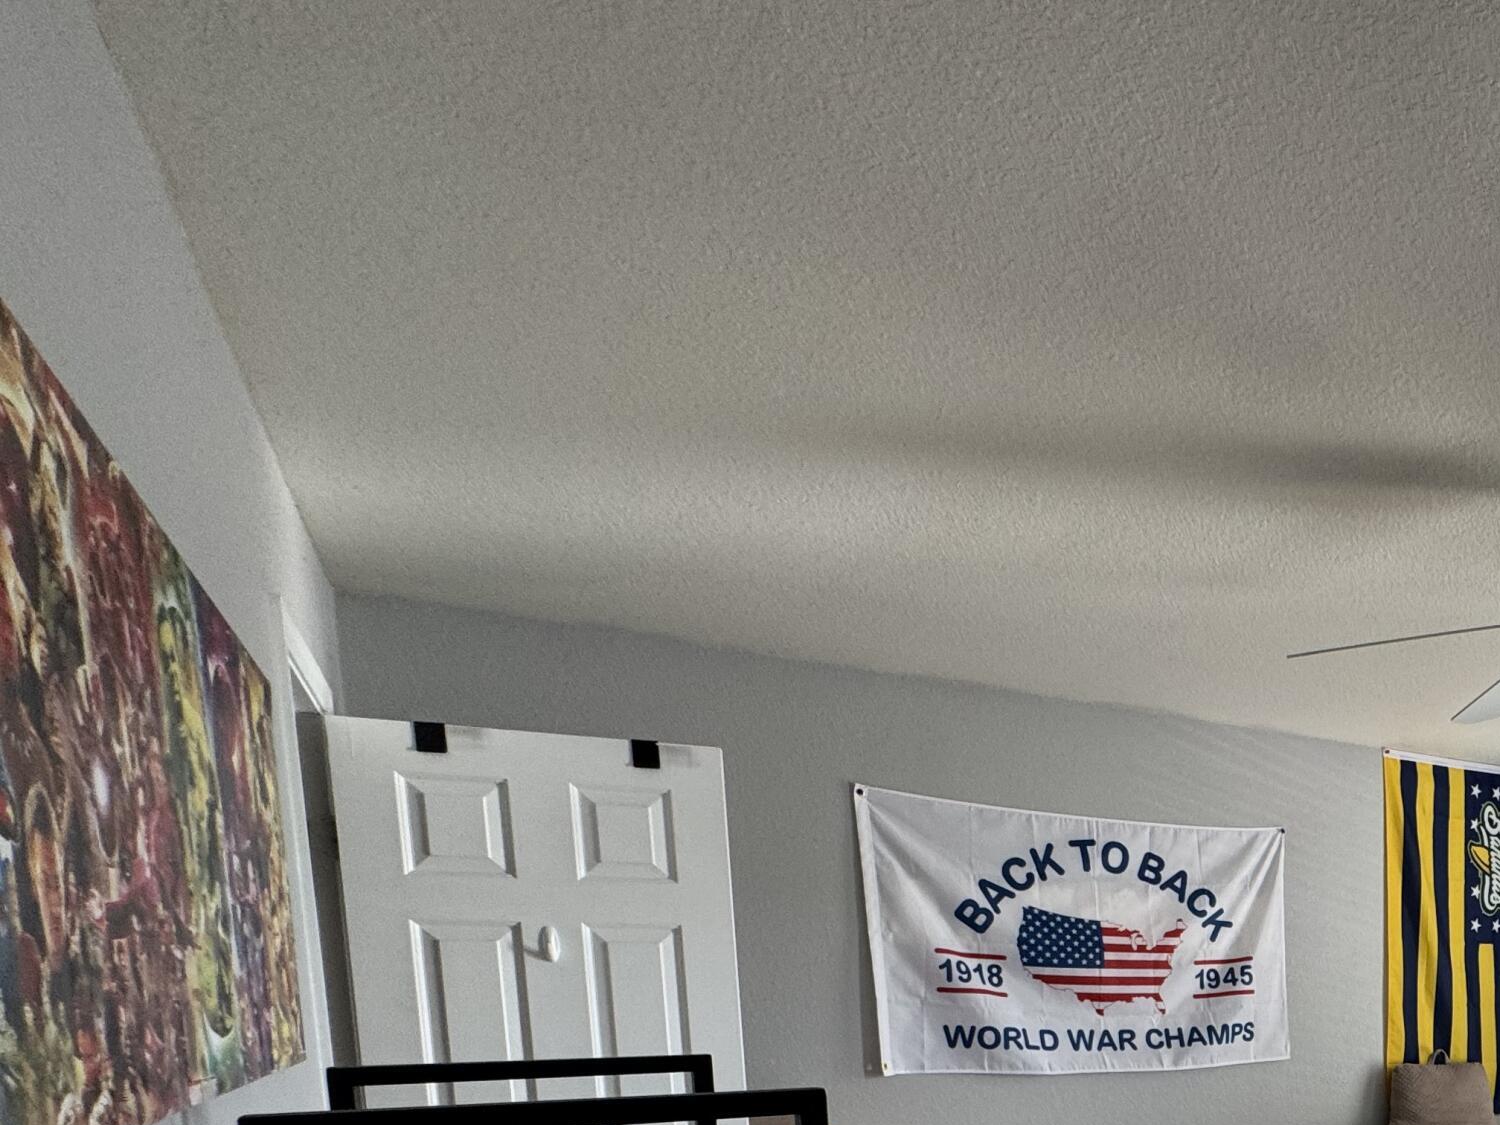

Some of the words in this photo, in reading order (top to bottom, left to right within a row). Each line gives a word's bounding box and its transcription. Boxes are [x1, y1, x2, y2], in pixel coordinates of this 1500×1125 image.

[954, 842, 1065, 934] BACK
[1068, 839, 1129, 874] TO
[1137, 851, 1233, 942] BACK
[938, 958, 1003, 988] 1918
[1195, 965, 1253, 990] 1945
[943, 1025, 1058, 1051] WORLD
[1068, 1029, 1138, 1052] WAR
[1146, 1022, 1255, 1049] CHAMPS
